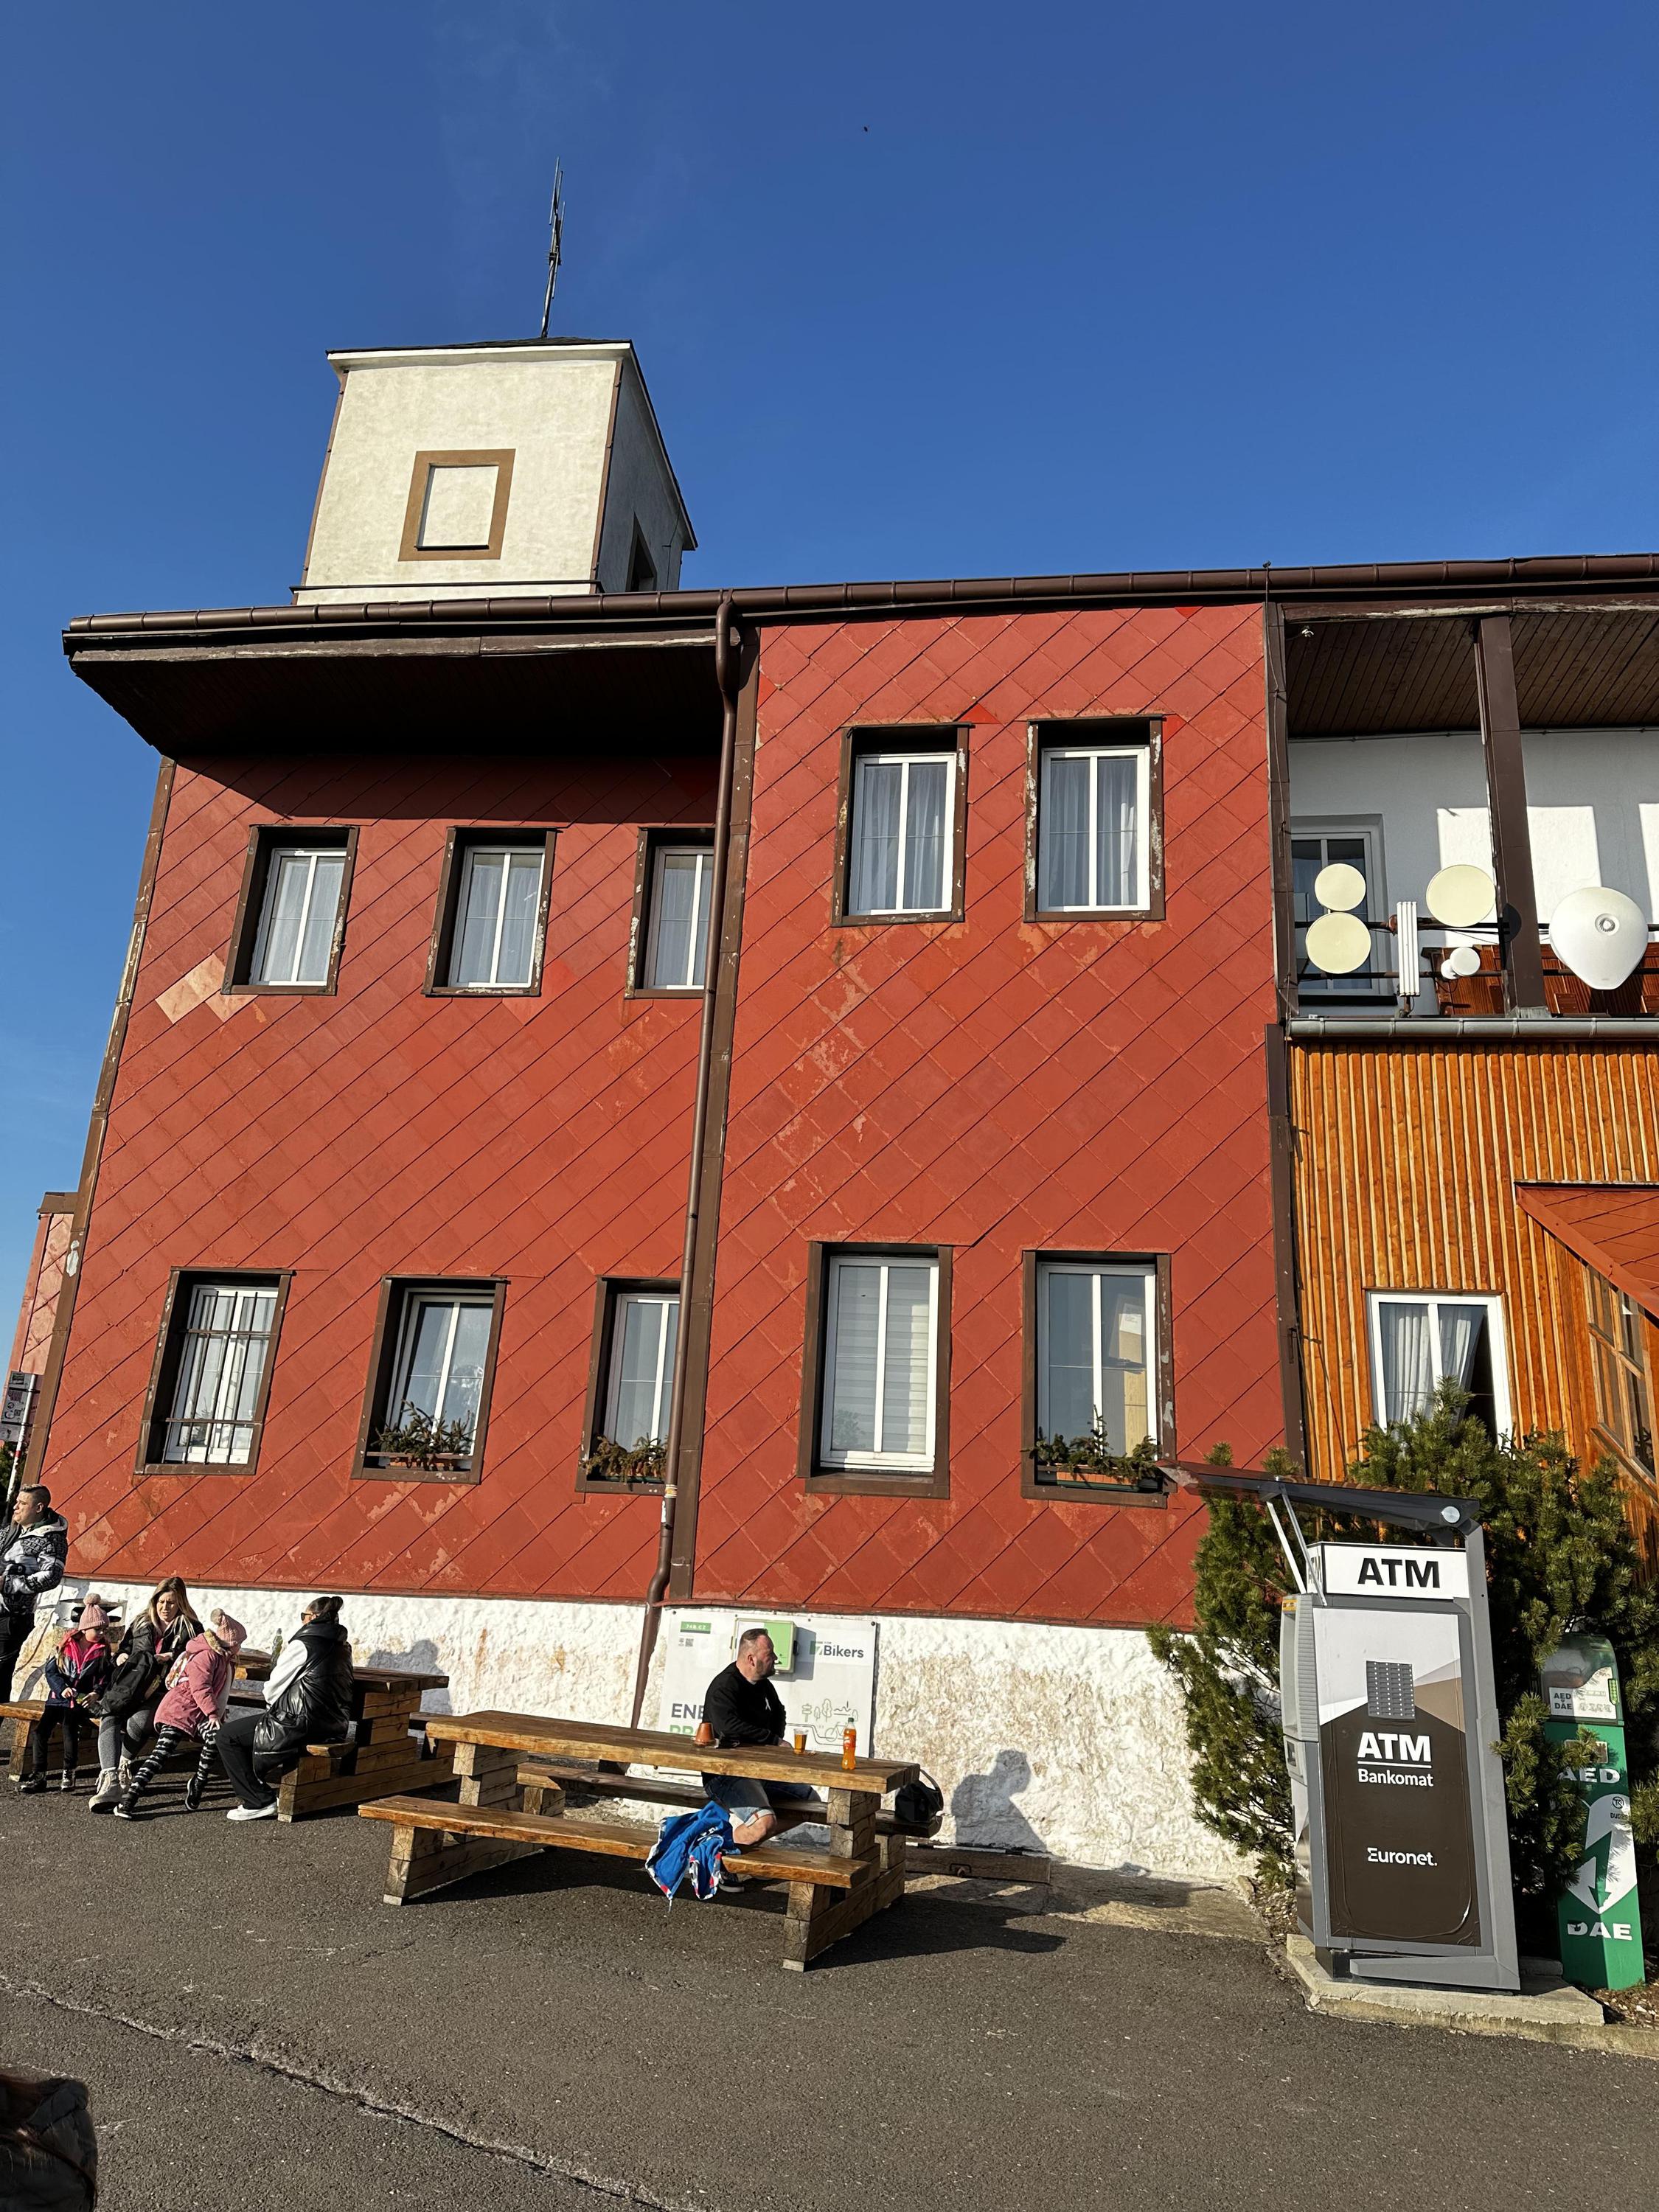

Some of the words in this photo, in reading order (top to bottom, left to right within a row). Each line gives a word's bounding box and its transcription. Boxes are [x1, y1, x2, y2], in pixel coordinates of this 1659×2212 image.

[1357, 1557, 1440, 1588] ATM
[824, 1644, 864, 1658] Bikers
[671, 1703, 705, 1720] ENE
[1357, 1732, 1432, 1762] ATM
[1358, 1768, 1434, 1787] Bankomat
[1557, 1767, 1621, 1784] AED
[1567, 1921, 1633, 1941] DAE
